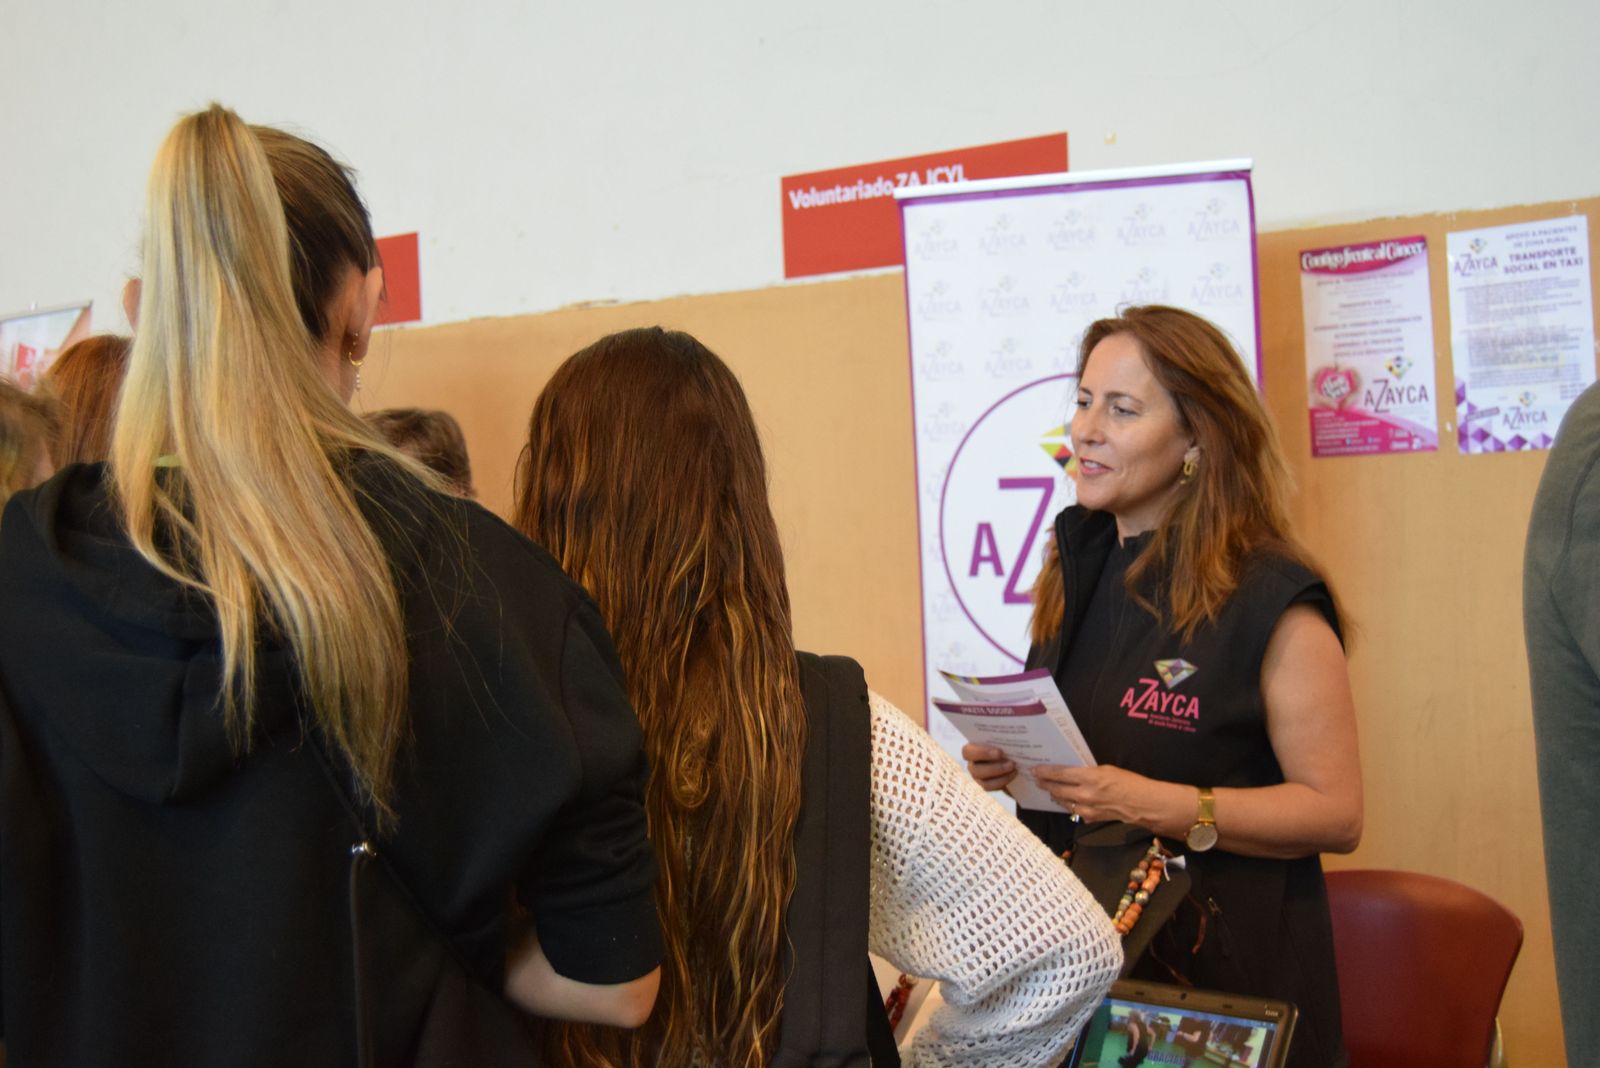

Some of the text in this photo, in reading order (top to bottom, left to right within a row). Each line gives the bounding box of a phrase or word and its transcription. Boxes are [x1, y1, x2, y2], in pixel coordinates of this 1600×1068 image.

[788, 176, 894, 210] Voluntariado
[1454, 253, 1498, 277] AZAYCA
[1503, 257, 1584, 275] SOCIAL EN TAXI
[1508, 246, 1577, 263] TRANSPORTE
[1363, 379, 1429, 413] AZAYCA
[1502, 406, 1548, 430] AZAYCA
[1119, 678, 1200, 720] AZAYCA
